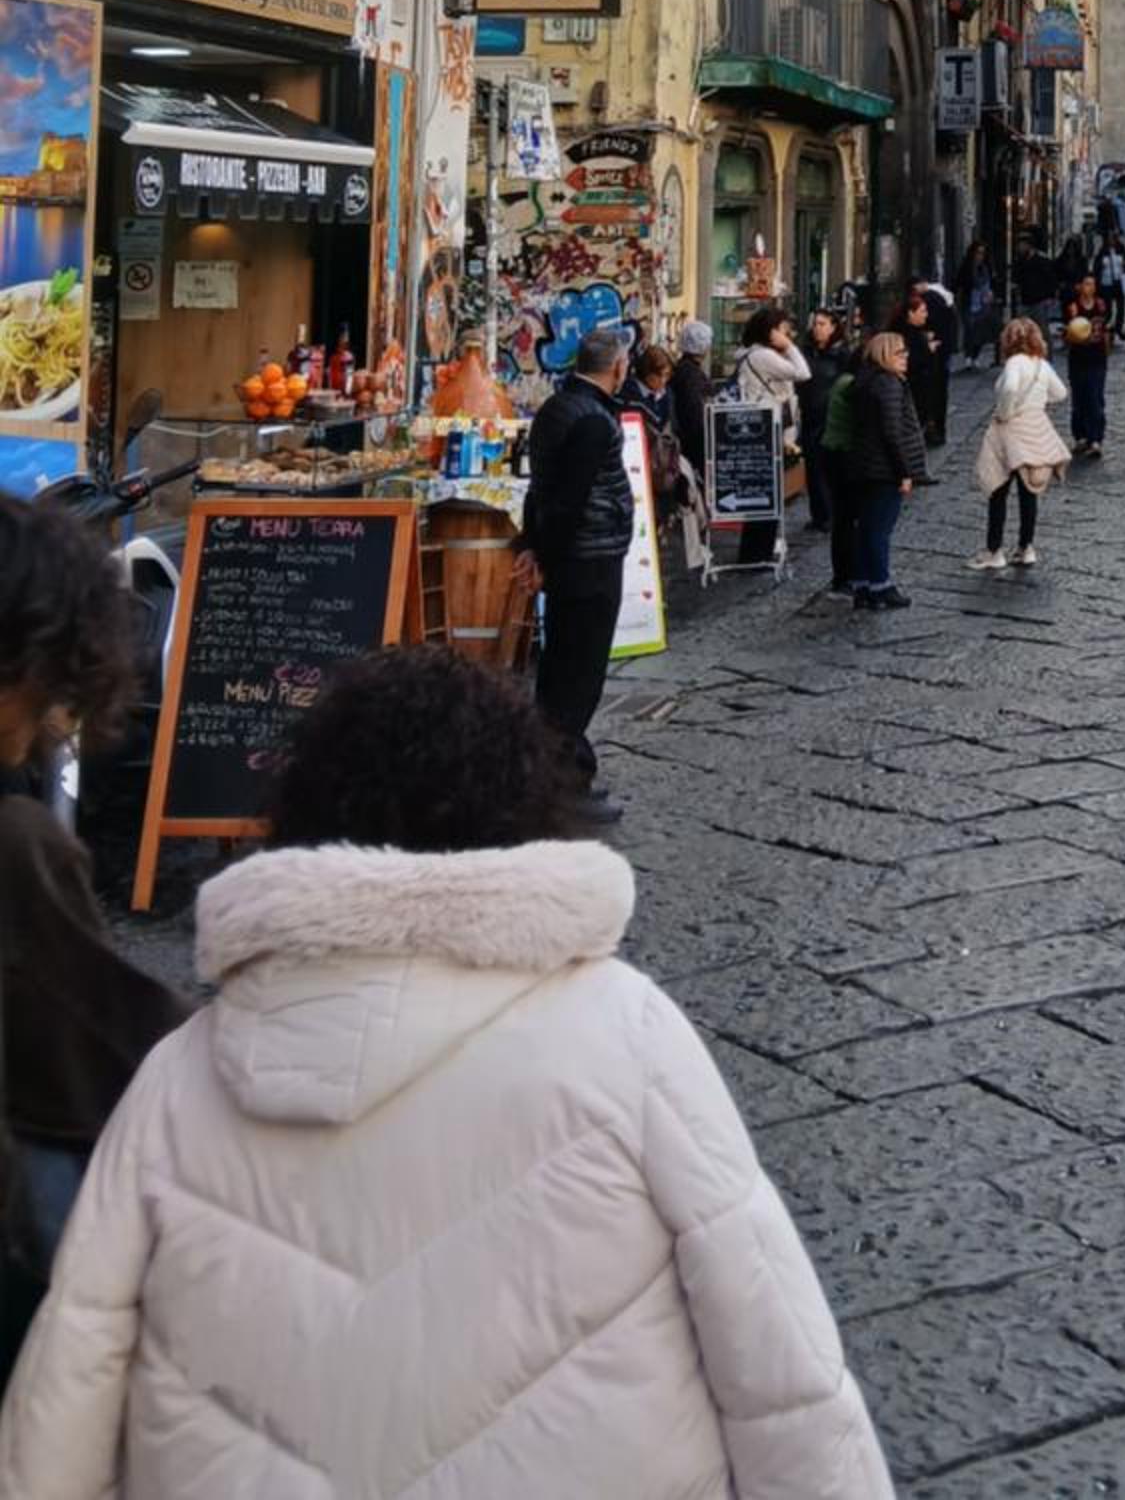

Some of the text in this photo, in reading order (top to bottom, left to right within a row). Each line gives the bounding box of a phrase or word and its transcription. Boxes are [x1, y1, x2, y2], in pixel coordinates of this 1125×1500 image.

[581, 134, 639, 157] FRIENDS
[179, 151, 249, 192] RISTORANTE
[256, 160, 301, 195] PIZZERIA
[250, 519, 301, 538] MENU
[223, 679, 320, 708] MENU PIZZ
